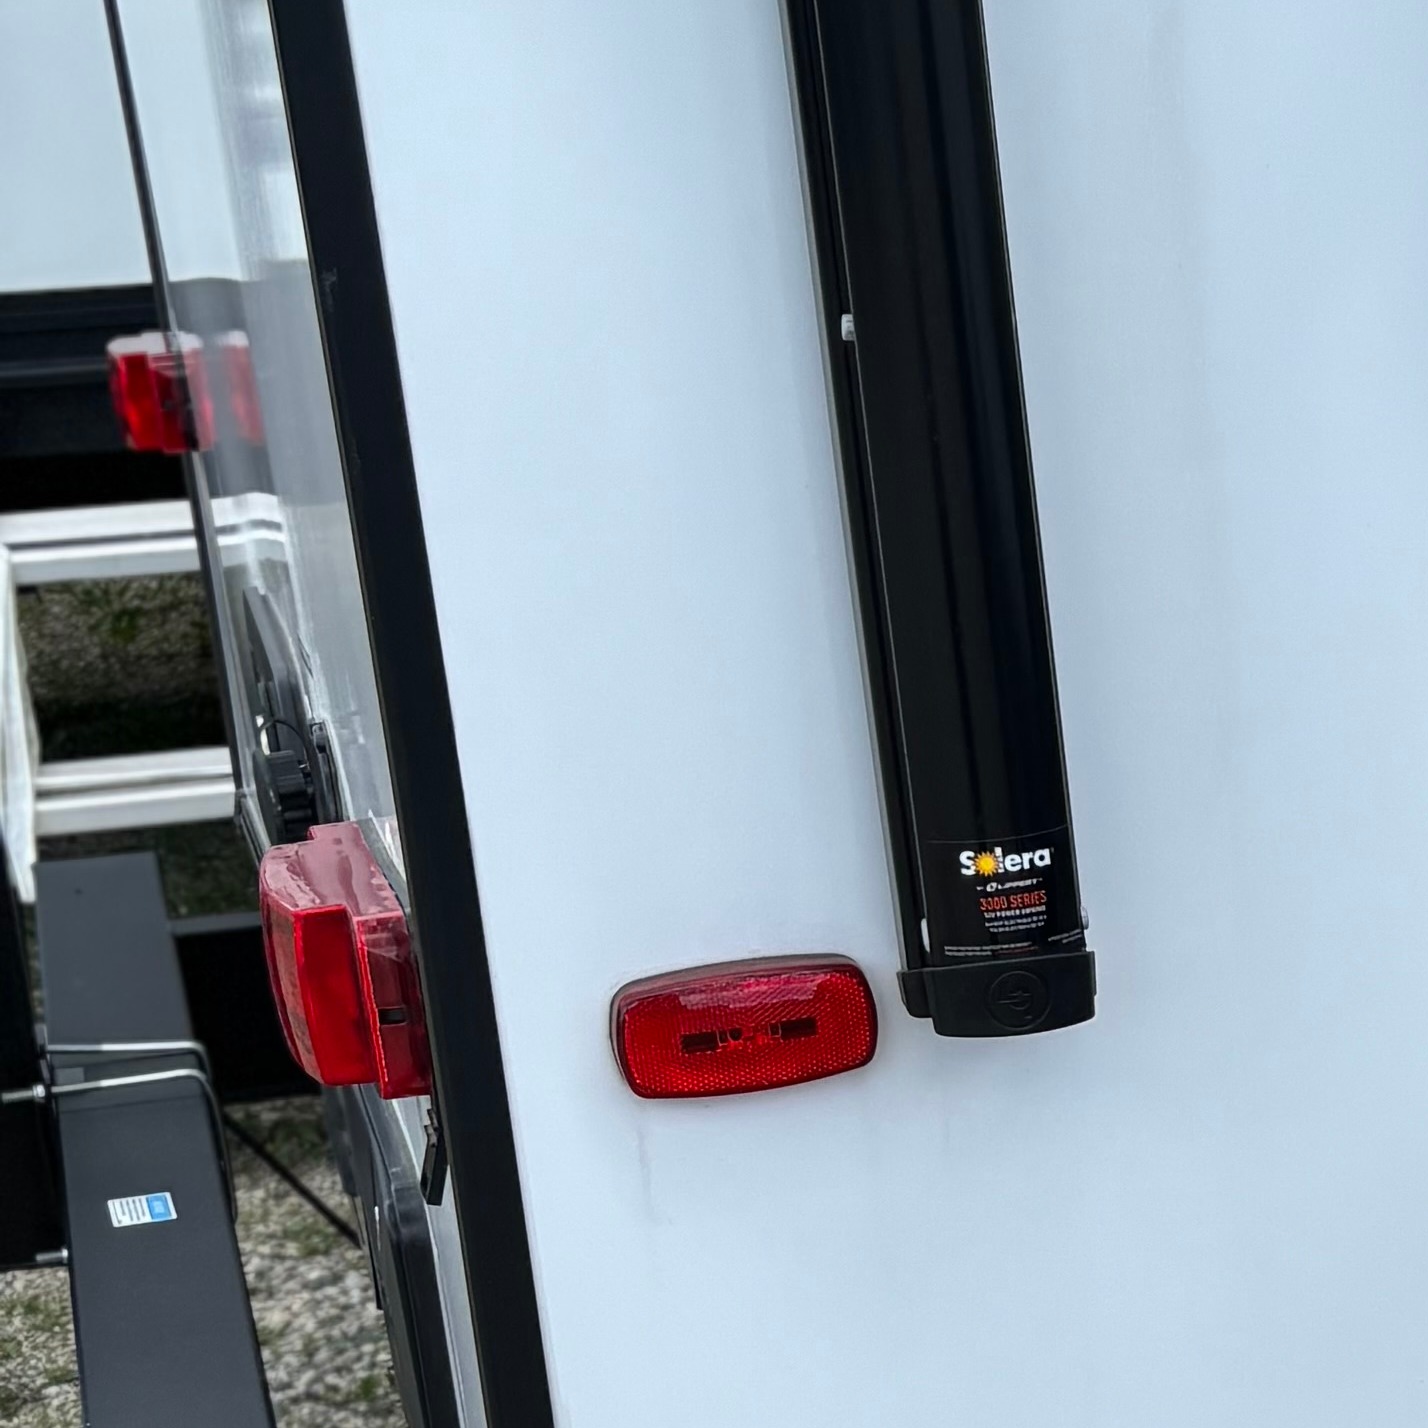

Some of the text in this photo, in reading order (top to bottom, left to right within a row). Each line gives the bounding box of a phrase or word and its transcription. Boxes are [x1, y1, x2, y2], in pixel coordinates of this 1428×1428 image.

[959, 846, 1051, 876] Solera
[980, 890, 1047, 911] 3000 SERIES
